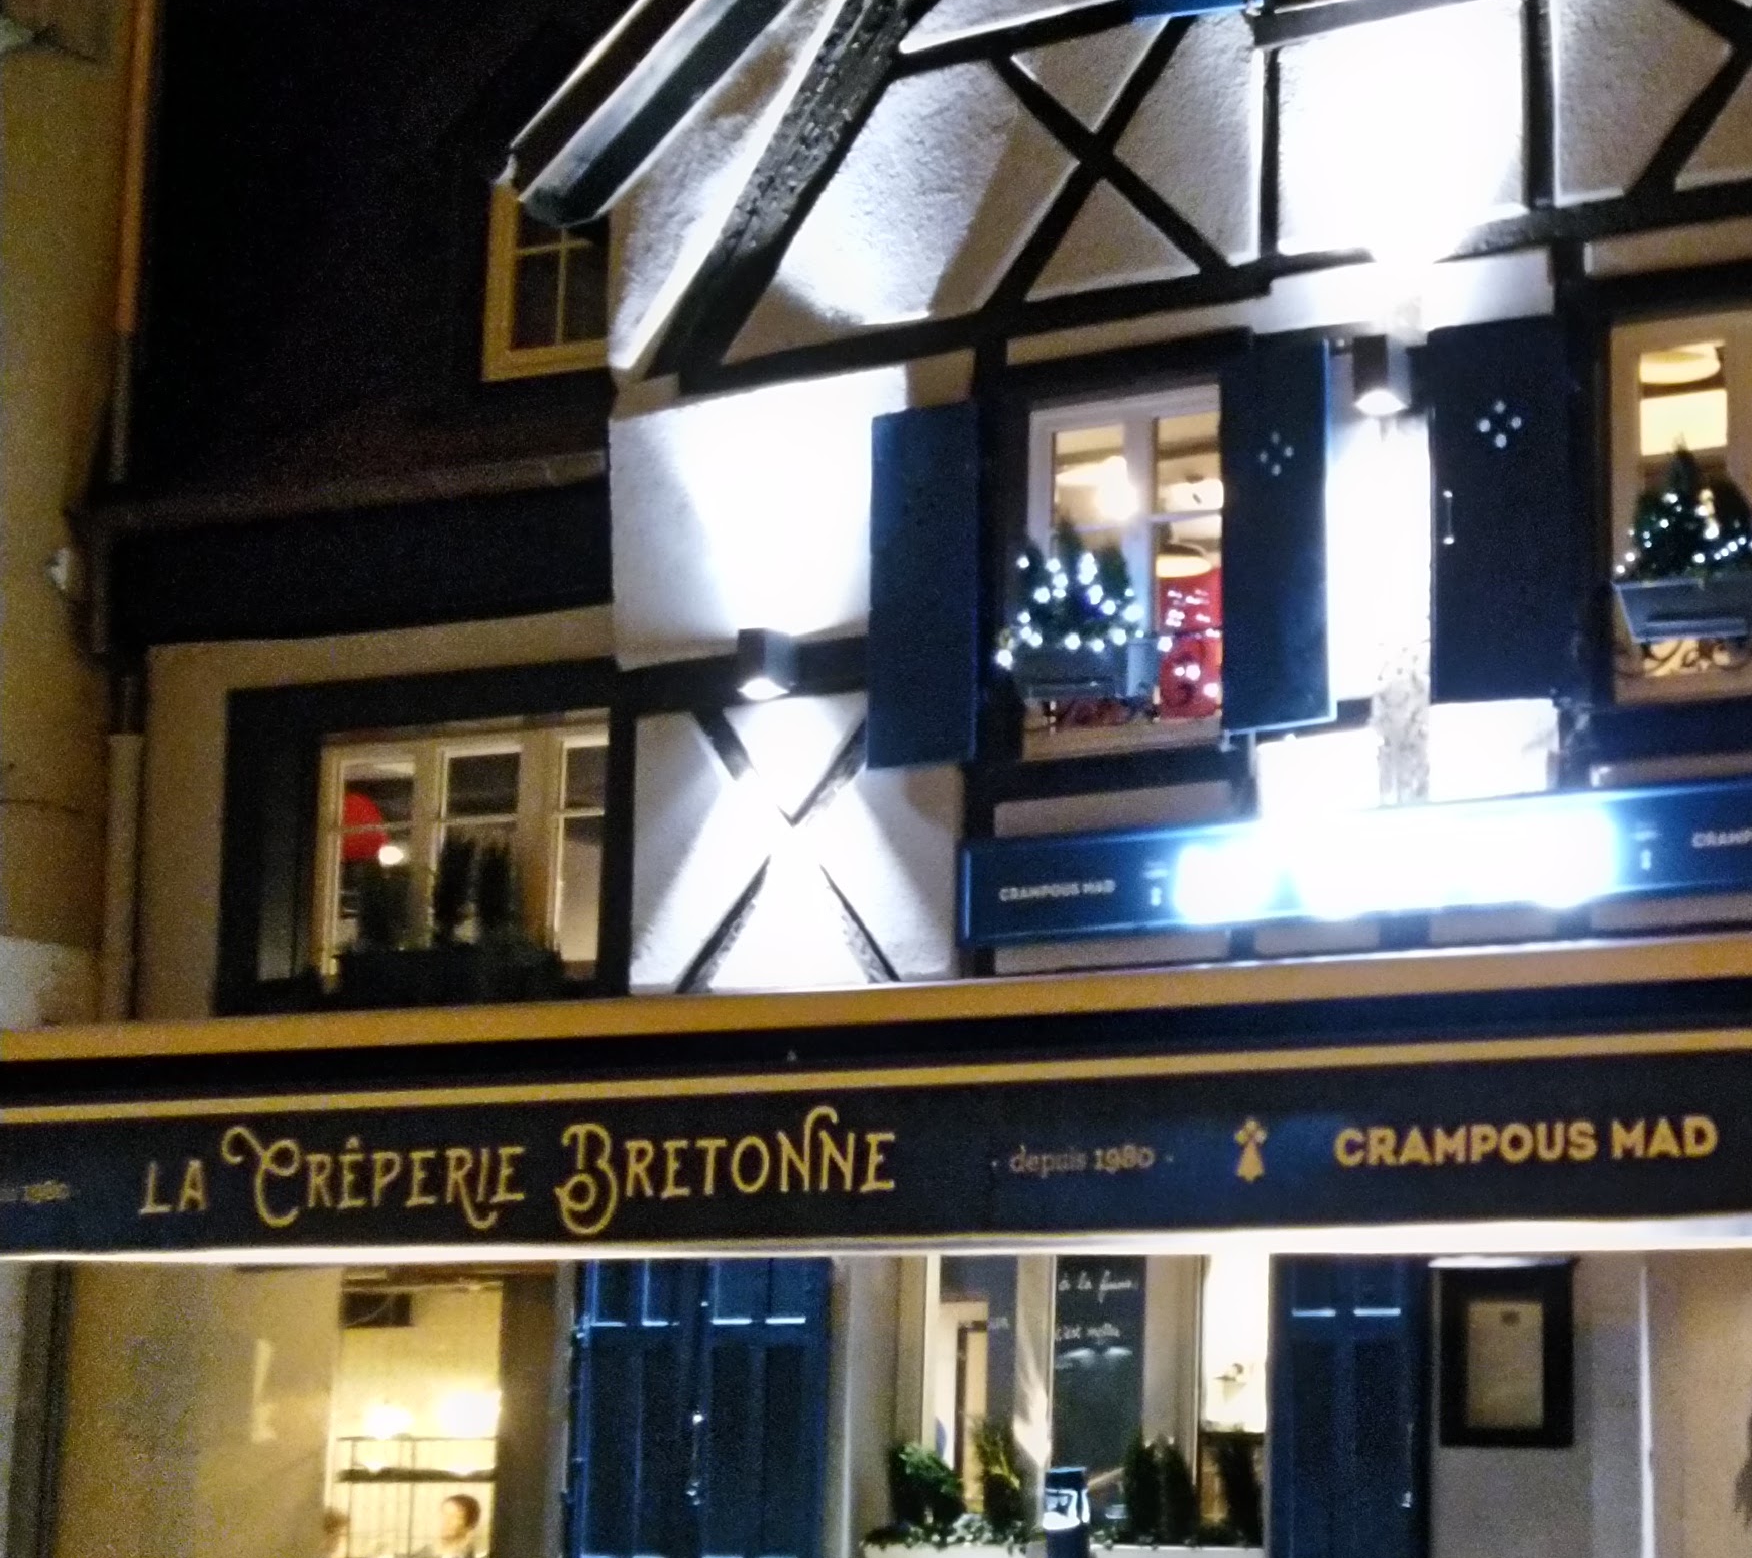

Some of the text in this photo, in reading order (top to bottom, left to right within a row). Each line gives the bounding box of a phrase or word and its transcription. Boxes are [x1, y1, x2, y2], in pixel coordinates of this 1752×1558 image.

[1083, 878, 1116, 894] MAD
[1009, 1144, 1155, 1179] depuis 1980
[1334, 1115, 1718, 1166] CRAMPOUS MAD
[138, 1104, 898, 1235] LA CRÊPERIE BRETONNE
